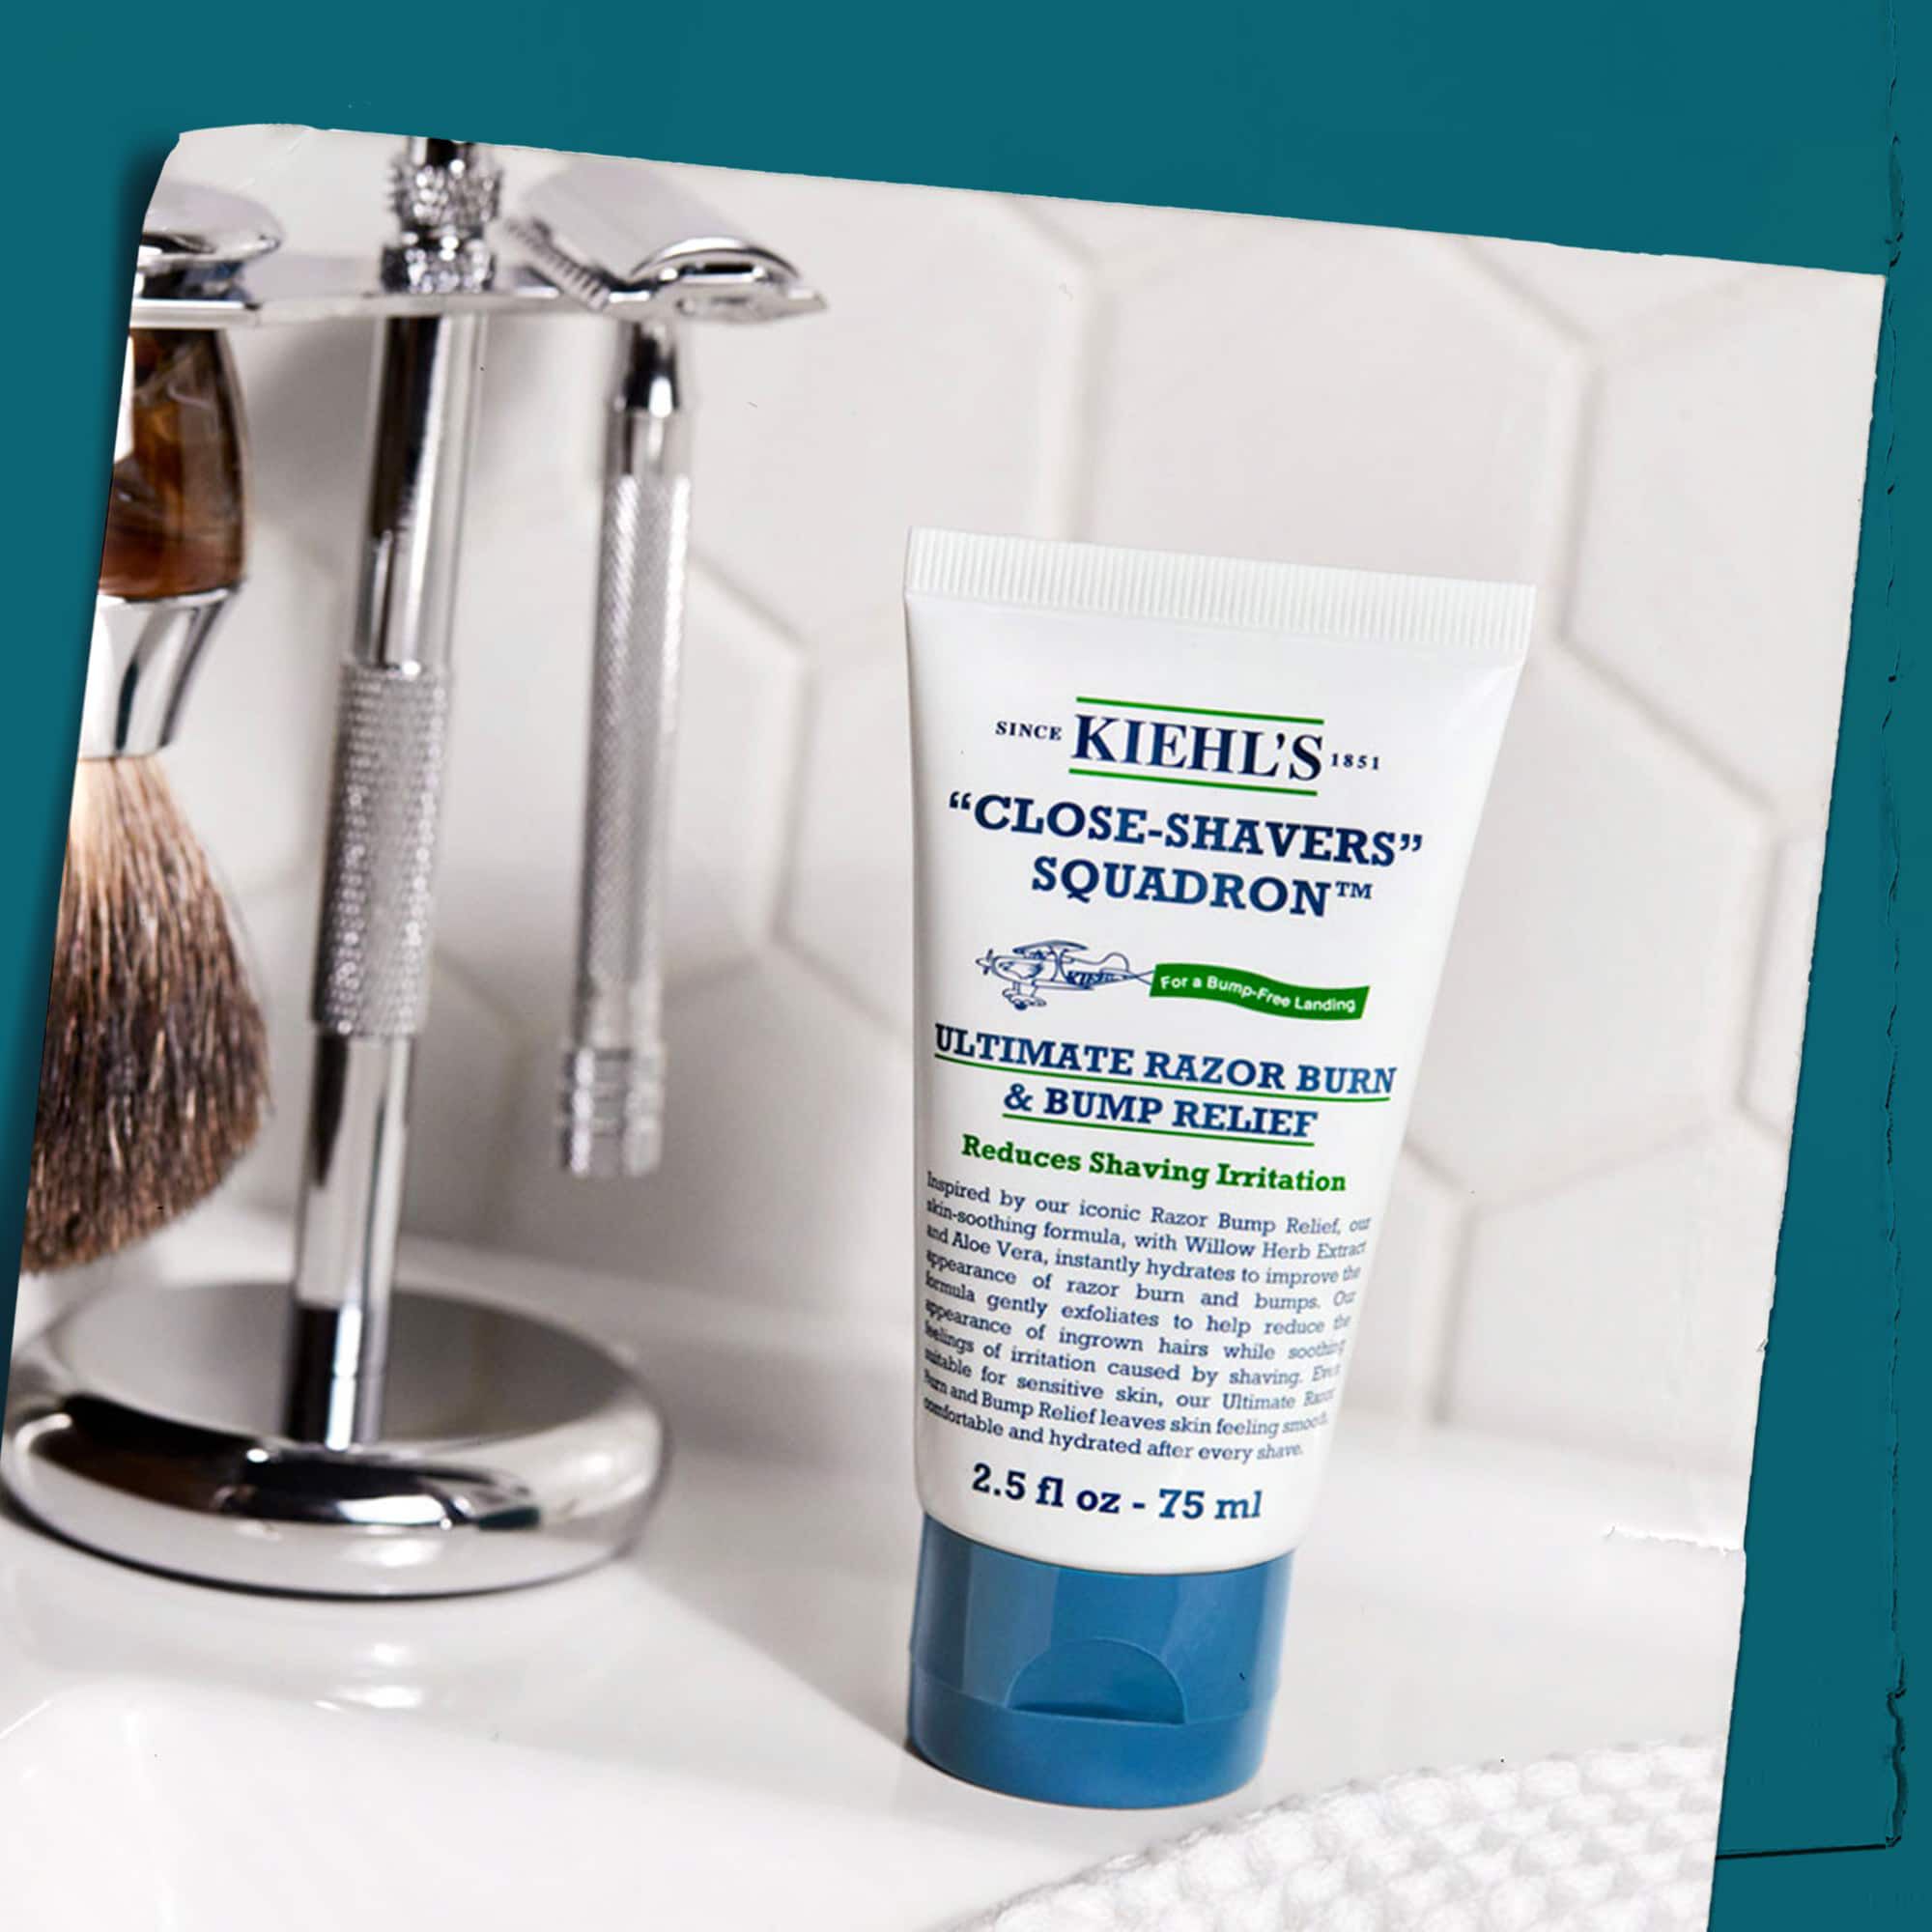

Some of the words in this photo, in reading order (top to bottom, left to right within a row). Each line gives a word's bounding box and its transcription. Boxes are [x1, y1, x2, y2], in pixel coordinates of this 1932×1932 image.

[996, 721, 1062, 741] SINCE
[1071, 713, 1323, 781] KIEHL'S
[1330, 753, 1380, 770] 1851
[949, 791, 1423, 867] “CLOSE-SHAVERS”
[1160, 976, 1187, 989] For
[1193, 977, 1202, 987] a
[1208, 976, 1291, 1008] Bump-Free
[1294, 997, 1355, 1012] Landing
[935, 1023, 1134, 1075] ULTIMATE
[1144, 1050, 1286, 1091] RAZOR
[1296, 1064, 1397, 1094] BURN
[1004, 1083, 1033, 1112] &
[1043, 1087, 1163, 1123] BUMP
[1172, 1100, 1319, 1137] RELIEF
[961, 1133, 1081, 1172] Reduces
[1089, 1151, 1209, 1190] Shaving
[1216, 1163, 1346, 1191] Irritation
[927, 1171, 990, 1203] Inspired
[1000, 1190, 1025, 1212] by
[1036, 1199, 1069, 1214] our
[1080, 1200, 1141, 1222] iconic
[1151, 1207, 1208, 1228] Razor
[1218, 1213, 1276, 1236] Bump
[1286, 1217, 1342, 1235] Relief,
[952, 1233, 990, 1254] Aloe
[997, 1241, 1048, 1264] Vera,
[1056, 1249, 1141, 1278] instantly
[1147, 1259, 1236, 1280] hydrates
[1241, 1268, 1260, 1283] to
[1265, 1267, 1339, 1289] improve
[1043, 1222, 1126, 1247] formula,
[1135, 1233, 1178, 1251] with
[1185, 1236, 1255, 1257] Willow
[1262, 1242, 1310, 1260] Herb
[987, 1293, 1048, 1319] gently
[1062, 1304, 1159, 1327] exfoliates
[1174, 1315, 1193, 1330] to
[1207, 1316, 1251, 1338] help
[1264, 1319, 1325, 1334] reduce
[1033, 1274, 1053, 1290] of
[1067, 1278, 1120, 1297] razor
[1136, 1283, 1184, 1304] burn
[1201, 1292, 1238, 1307] and
[1255, 1293, 1321, 1314] bumps.
[983, 1343, 1003, 1358] of
[1011, 1346, 1095, 1373] irritation
[1107, 1362, 1179, 1381] caused
[1192, 1366, 1219, 1386] by
[1026, 1324, 1046, 1340] of
[1060, 1327, 1144, 1352] ingrown
[1159, 1337, 1208, 1357] hairs
[1224, 1343, 1275, 1360] while
[951, 1385, 978, 1405] and
[981, 1391, 1034, 1419] Bump
[1038, 1404, 1097, 1424] Relief
[1101, 1408, 1166, 1431] leaves
[1170, 1416, 1211, 1435] skin
[1216, 1418, 1279, 1438] feeling
[981, 1366, 1007, 1384] for
[1017, 1376, 1104, 1399] sensitive
[1115, 1386, 1163, 1407] skin,
[1176, 1394, 1210, 1408] our
[1222, 1393, 1295, 1410] Ultimate
[1009, 1425, 1043, 1443] and
[1049, 1429, 1142, 1455] hydrated
[1147, 1440, 1194, 1459] after
[1198, 1447, 1253, 1464] every
[972, 1463, 1027, 1500] 2.5
[1036, 1475, 1064, 1508] fl
[1076, 1488, 1121, 1514] oz
[1158, 1488, 1206, 1519] 75
[1215, 1491, 1263, 1520] ml
